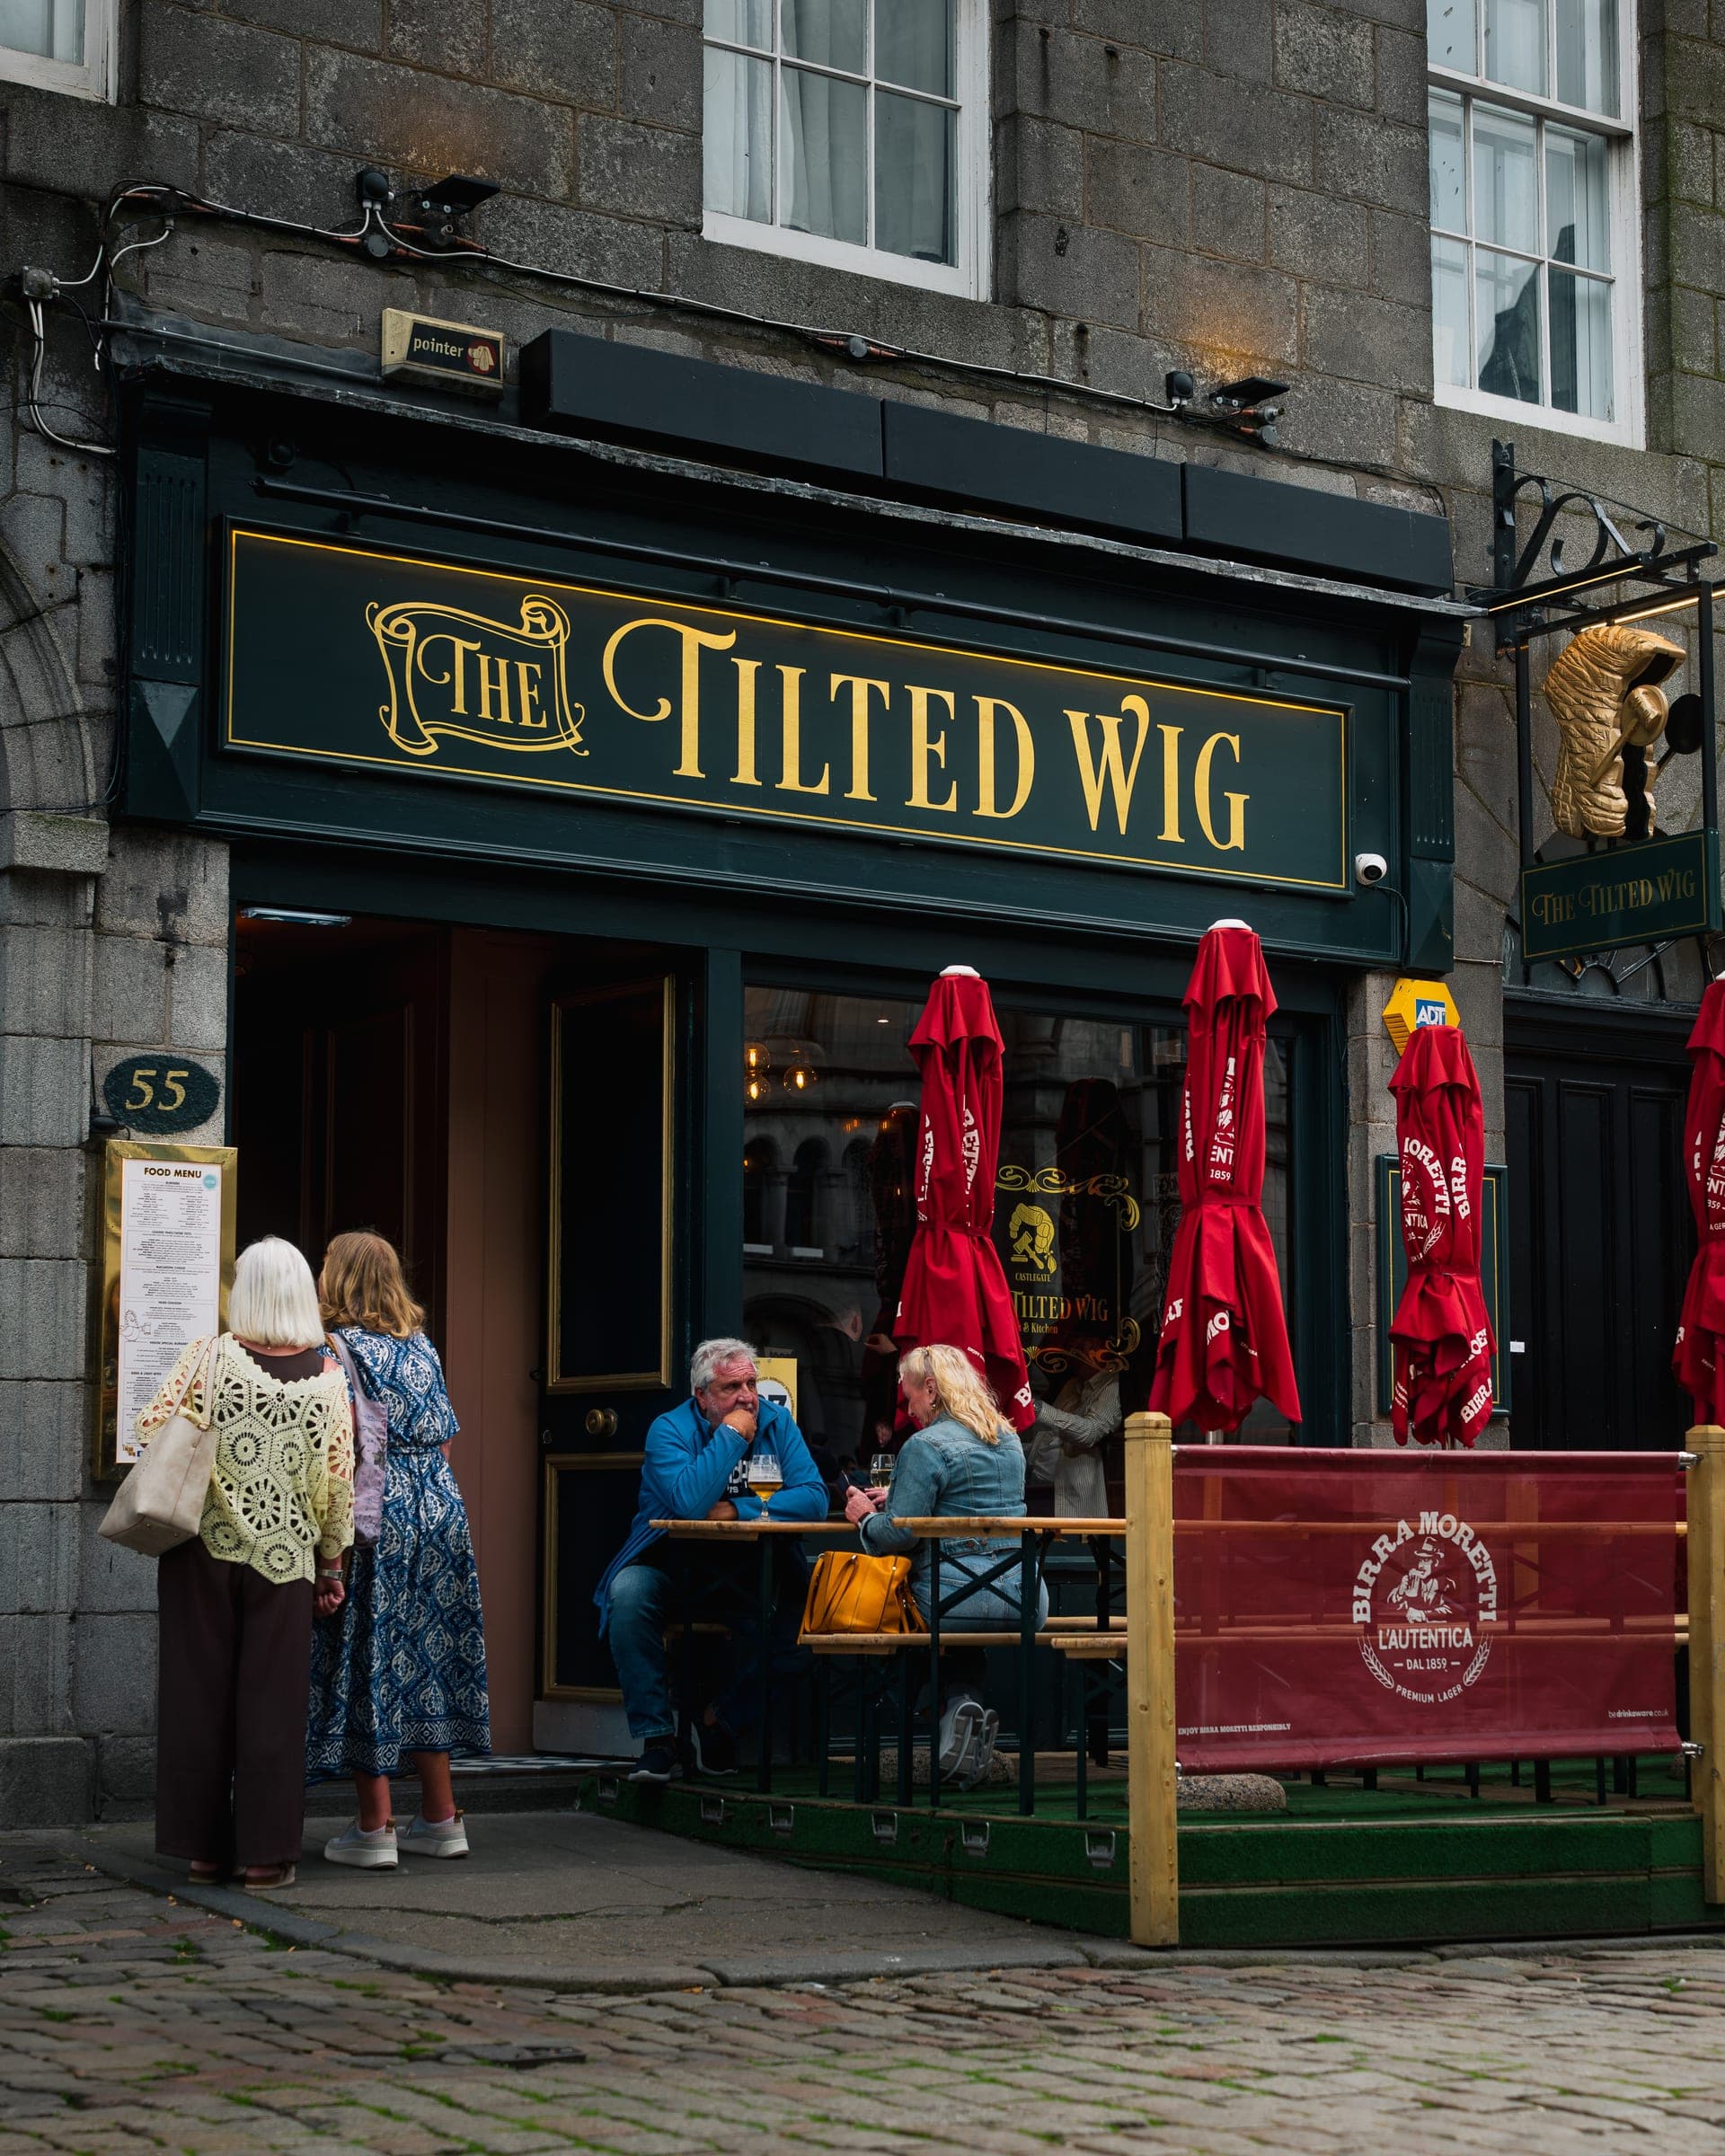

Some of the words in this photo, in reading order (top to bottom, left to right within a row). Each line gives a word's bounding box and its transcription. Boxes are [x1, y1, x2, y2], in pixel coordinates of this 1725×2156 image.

[413, 337, 464, 358] pointer
[417, 633, 548, 729] THE
[603, 618, 1035, 819] TILTED
[1063, 694, 1250, 852] WIG
[1531, 892, 1576, 925] THE
[1579, 879, 1653, 916] TILTED
[1656, 868, 1696, 903] WIG
[1416, 1005, 1446, 1026] ADT
[125, 1069, 189, 1110] 55
[144, 1167, 171, 1177] FOOD
[173, 1169, 202, 1179] MENU
[1451, 1144, 1471, 1220] BIRR
[1014, 1272, 1051, 1283] CASTLEGATE
[1010, 1290, 1072, 1320] TILTED
[1075, 1293, 1109, 1321] WIG
[1031, 1321, 1058, 1334] Kitchen
[1352, 1519, 1416, 1623] BIRRA
[1418, 1511, 1498, 1621] MORETTI
[1379, 1627, 1473, 1650] L'AUTENTICA
[1406, 1659, 1424, 1670] DAL
[1426, 1658, 1447, 1670] 1859
[1395, 1684, 1435, 1703] PREMIUM
[1438, 1683, 1464, 1702] LAGER
[1178, 1727, 1199, 1736] ENJOY
[1220, 1725, 1248, 1733] MORETTI
[1248, 1723, 1292, 1732] RESPONSIBLY
